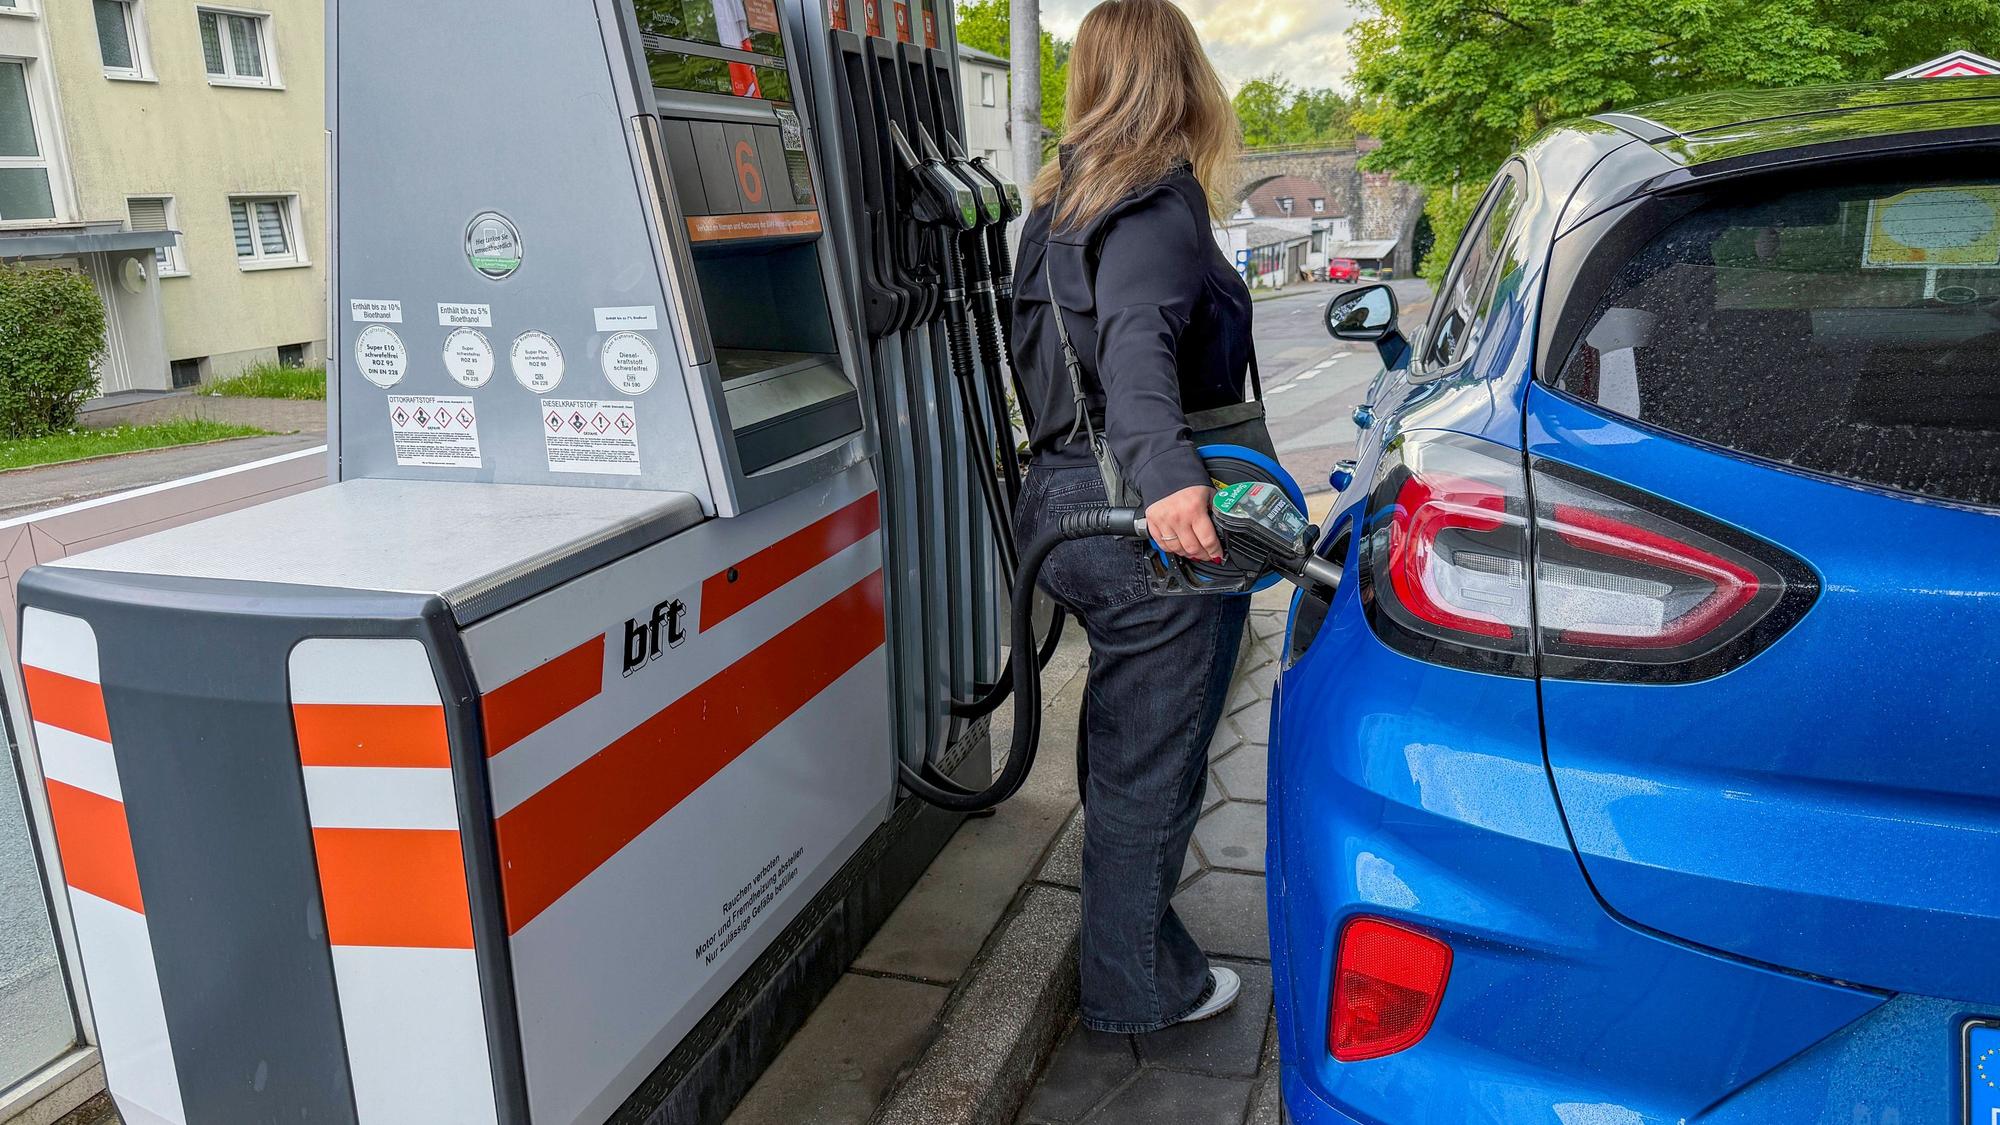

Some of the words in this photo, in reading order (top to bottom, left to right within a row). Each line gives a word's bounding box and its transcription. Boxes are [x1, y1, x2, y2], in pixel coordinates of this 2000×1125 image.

[735, 140, 762, 204] 6
[352, 302, 371, 310] Enthält
[371, 303, 380, 311] bis
[440, 306, 460, 315] Enthält
[460, 307, 469, 315] bis
[363, 311, 391, 319] Bioethanol
[450, 314, 480, 323] Bioethanol
[389, 396, 436, 404] OTTOKRAFTSTOFF
[542, 400, 598, 409] DIESELKRAFTSTOFF
[622, 598, 686, 678] bft
[723, 881, 752, 915] Rauchen
[753, 855, 780, 885] verboten
[695, 933, 717, 959] Motor
[717, 916, 732, 937] und
[732, 873, 777, 922] Fremdheizung
[778, 846, 804, 877] abstellen
[705, 948, 719, 966] Nur
[720, 916, 751, 953] zulässige
[752, 892, 774, 918] Gefäße
[775, 867, 799, 895] befüllen
